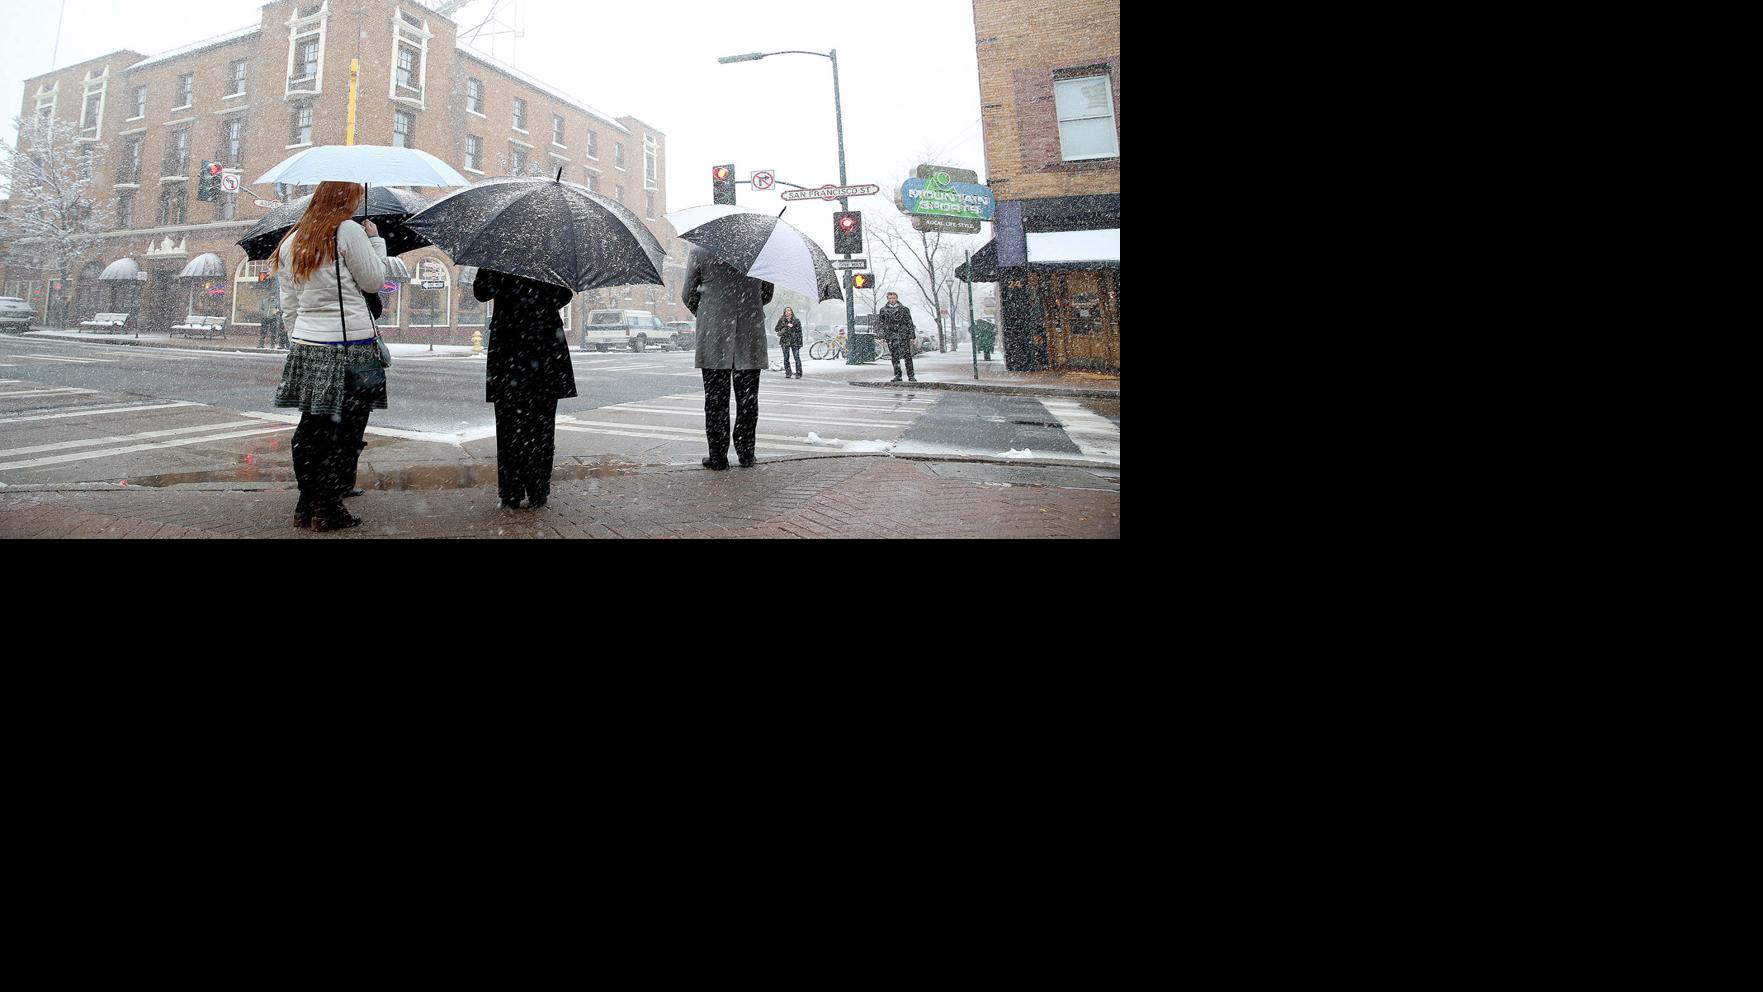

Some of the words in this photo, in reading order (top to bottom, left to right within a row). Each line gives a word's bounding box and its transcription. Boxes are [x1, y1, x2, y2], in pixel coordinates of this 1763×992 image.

[788, 191, 806, 199] SAN
[808, 187, 858, 198] FRANCISCO
[908, 189, 991, 205] MOUNTAIN
